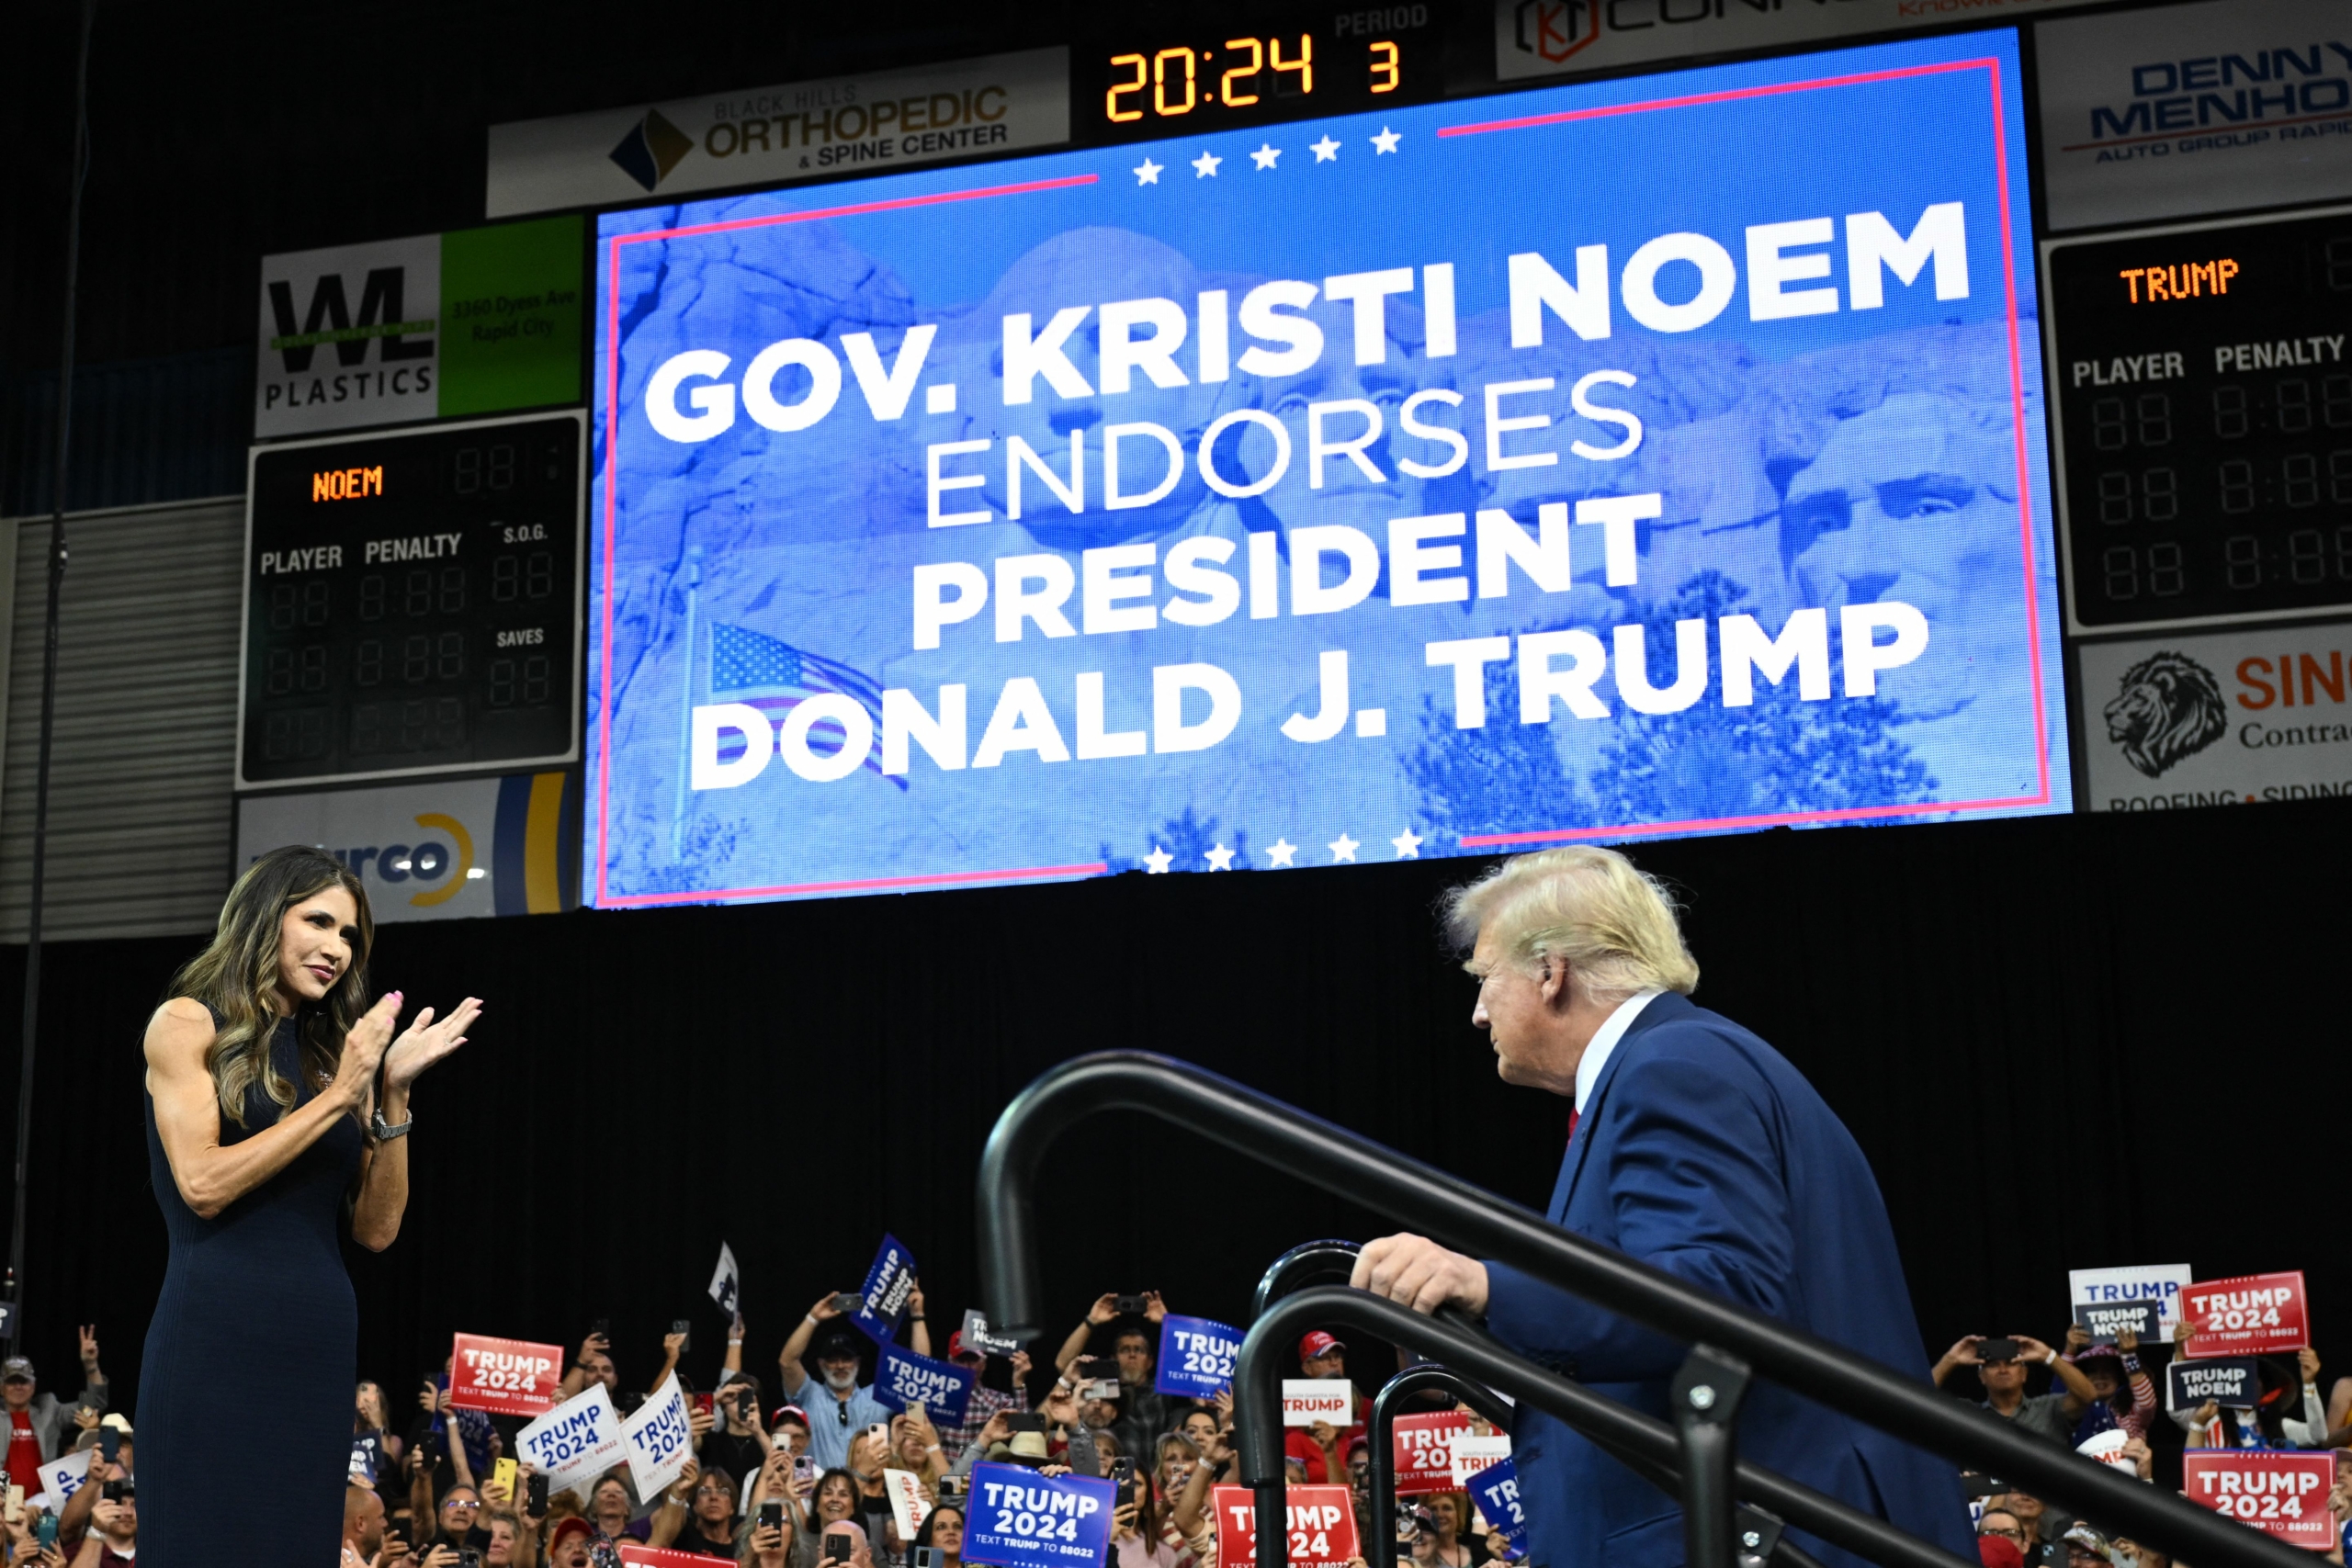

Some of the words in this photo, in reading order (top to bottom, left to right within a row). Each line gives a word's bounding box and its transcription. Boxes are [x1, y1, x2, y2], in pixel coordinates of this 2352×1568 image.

[1335, 5, 1428, 37] PERIOD
[1107, 33, 1312, 122] 20:24
[1370, 40, 1399, 93] 3
[715, 93, 784, 119] BLACK
[795, 84, 857, 109] HILLS
[705, 85, 1008, 158] ORTHOPEDIC
[817, 139, 894, 167] SPINE
[901, 123, 1008, 155] CENTER
[2096, 141, 2169, 164] AUTO
[2178, 130, 2269, 152] GROUP
[2120, 258, 2239, 303] TRUMP
[269, 265, 435, 374] WL
[646, 325, 956, 443] GOV.
[1002, 264, 1457, 405] KRISTI
[1508, 201, 1970, 347] NOEM
[2073, 352, 2185, 387] PLAYER
[2215, 334, 2345, 372] PENALTY
[266, 366, 431, 410] PLASTICS
[927, 369, 1643, 528] ENDORSES
[312, 465, 383, 502] NOEM
[503, 525, 548, 544] S.O.G.
[261, 546, 343, 575] PLAYER
[365, 533, 462, 564] PENALTY
[913, 492, 1662, 650] PRESIDENT
[497, 628, 544, 648] SAVES
[2235, 650, 2352, 710] SIN
[691, 662, 1242, 791] DONALD
[1280, 649, 1386, 742] J.
[1425, 602, 1929, 728] TRUMP
[2262, 781, 2352, 802] SIDIN
[860, 1248, 899, 1320] TRUMP
[2085, 1281, 2178, 1302] TRUMP
[2086, 1307, 2149, 1325] TRUMP
[2190, 1287, 2291, 1314] TRUMP
[2208, 1307, 2280, 1331] 2024
[2219, 1331, 2252, 1341] TRUMP
[2255, 1329, 2267, 1338] TO
[1173, 1330, 1240, 1360] TRUM
[464, 1348, 551, 1375] TRUMP
[887, 1355, 962, 1393] TRUMP
[1183, 1352, 1237, 1378] 202
[2180, 1368, 2246, 1385] TRUMP
[473, 1369, 537, 1393] 2024
[481, 1389, 509, 1399] TRUMP
[892, 1376, 946, 1406] 2024
[1168, 1371, 1190, 1381] TEXT
[1192, 1373, 1222, 1385] TRUMP
[2187, 1382, 2242, 1399] NOEM
[632, 1392, 682, 1450] TRUMP
[1283, 1399, 1344, 1412] TRUMP
[527, 1404, 600, 1454] TRUMP
[650, 1416, 687, 1464] 2024
[542, 1427, 599, 1469] 2024
[2198, 1471, 2320, 1495] TRUMP
[984, 1482, 1099, 1518] TRUMP
[2215, 1495, 2302, 1518] 2024
[994, 1509, 1077, 1541] 2024
[2269, 1522, 2284, 1531] TO
[976, 1534, 1001, 1545] TEXT
[1003, 1538, 1040, 1550] TRUMP
[1043, 1542, 1057, 1552] TO
[1060, 1545, 1094, 1558] 88022
